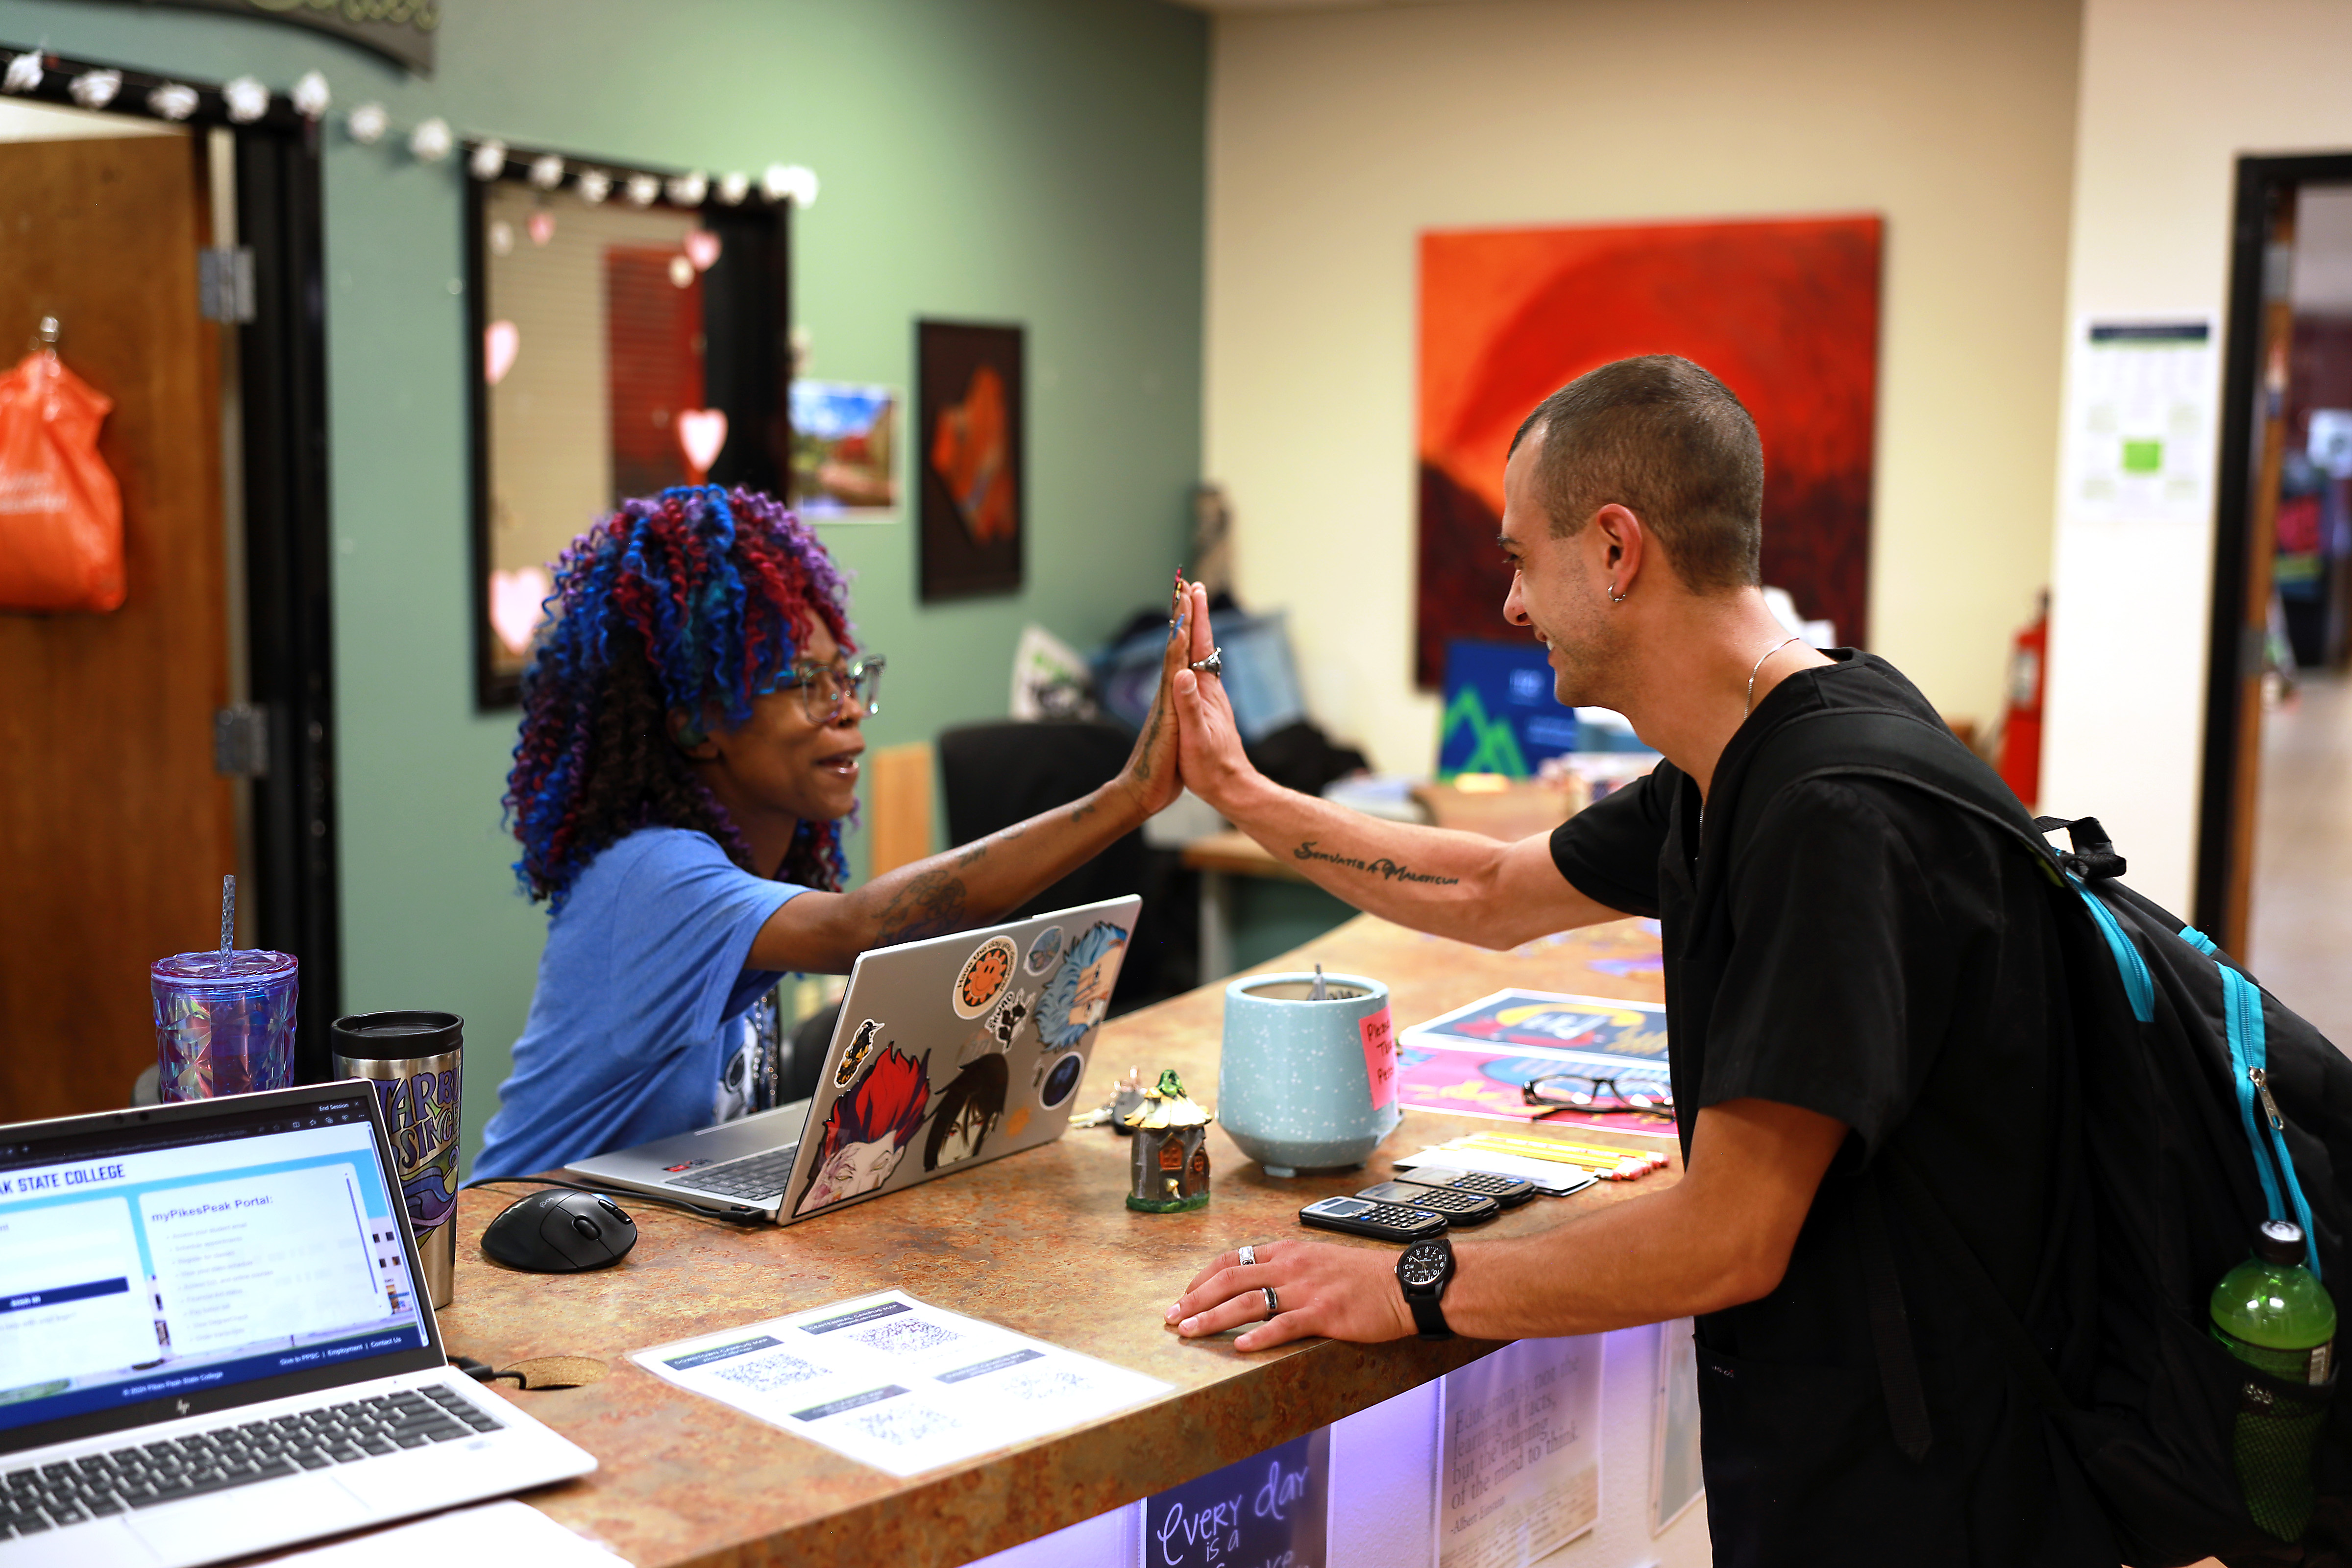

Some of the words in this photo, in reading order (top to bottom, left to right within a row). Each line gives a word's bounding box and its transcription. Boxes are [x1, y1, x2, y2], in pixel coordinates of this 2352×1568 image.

[18, 1173, 60, 1192] STATE
[65, 1164, 126, 1185] COLLEGE
[152, 1201, 231, 1222] myPikesPeak
[234, 1195, 273, 1209] Portal:
[327, 1344, 364, 1356] Employment
[1454, 1421, 1503, 1460] learning
[1451, 1485, 1465, 1509] of
[1471, 1468, 1490, 1499] the
[1494, 1447, 1523, 1486] mind
[1528, 1445, 1542, 1464] to
[1452, 1460, 1474, 1485] but
[1480, 1440, 1497, 1470] the
[1206, 1537, 1220, 1562] is
[1227, 1529, 1239, 1552] a
